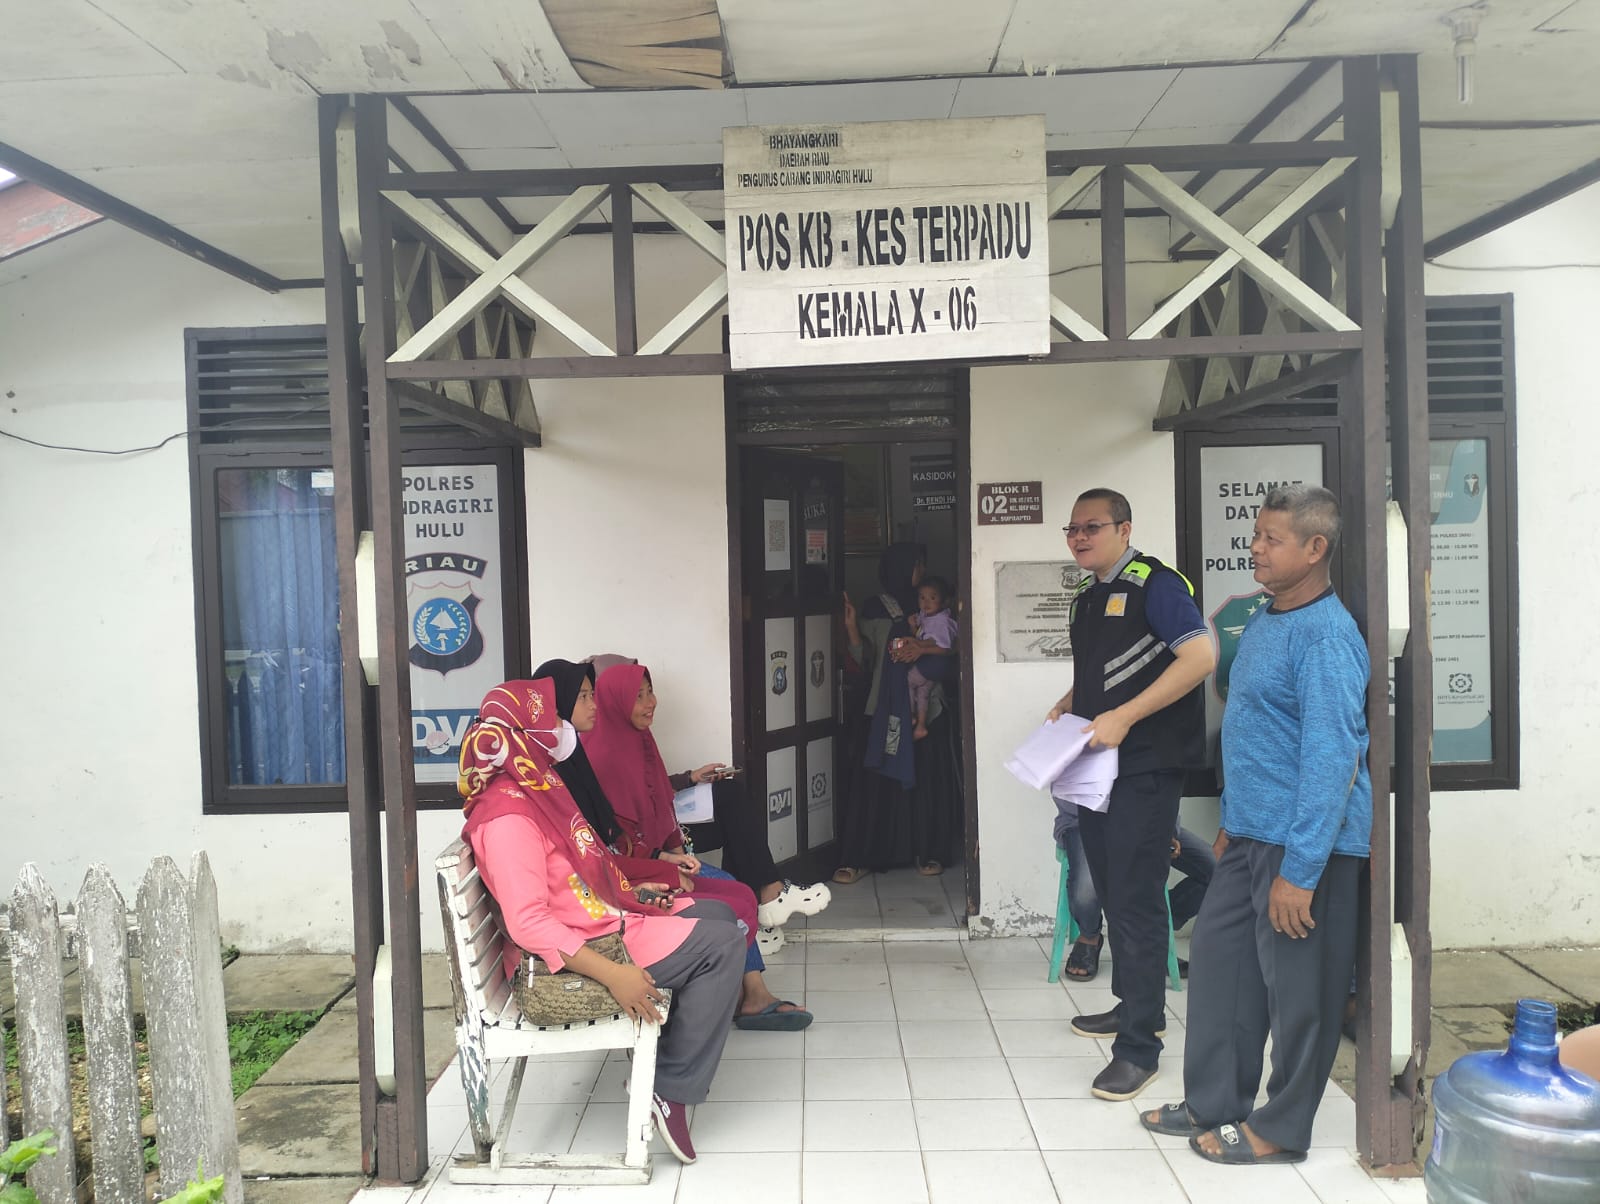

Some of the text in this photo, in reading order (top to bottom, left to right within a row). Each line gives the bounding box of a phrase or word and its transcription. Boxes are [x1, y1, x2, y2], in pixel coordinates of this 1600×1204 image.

[769, 132, 838, 150] BHAYANGKARI
[780, 152, 829, 168] DAERAH RIAU
[738, 168, 873, 188] PENGURUS CABANG INDRAGIRI HULU
[738, 202, 1032, 272] POS KB - KES TERPADU
[798, 286, 977, 339] KEMALA X - 06
[402, 476, 474, 491] POLRES
[991, 486, 1020, 494] BLOK
[1218, 480, 1302, 498] SELAM
[981, 495, 1008, 514] 02
[1226, 505, 1260, 520] DAT
[416, 522, 464, 538] HULU
[405, 556, 478, 573] RIAU
[1205, 557, 1256, 572] POLRE
